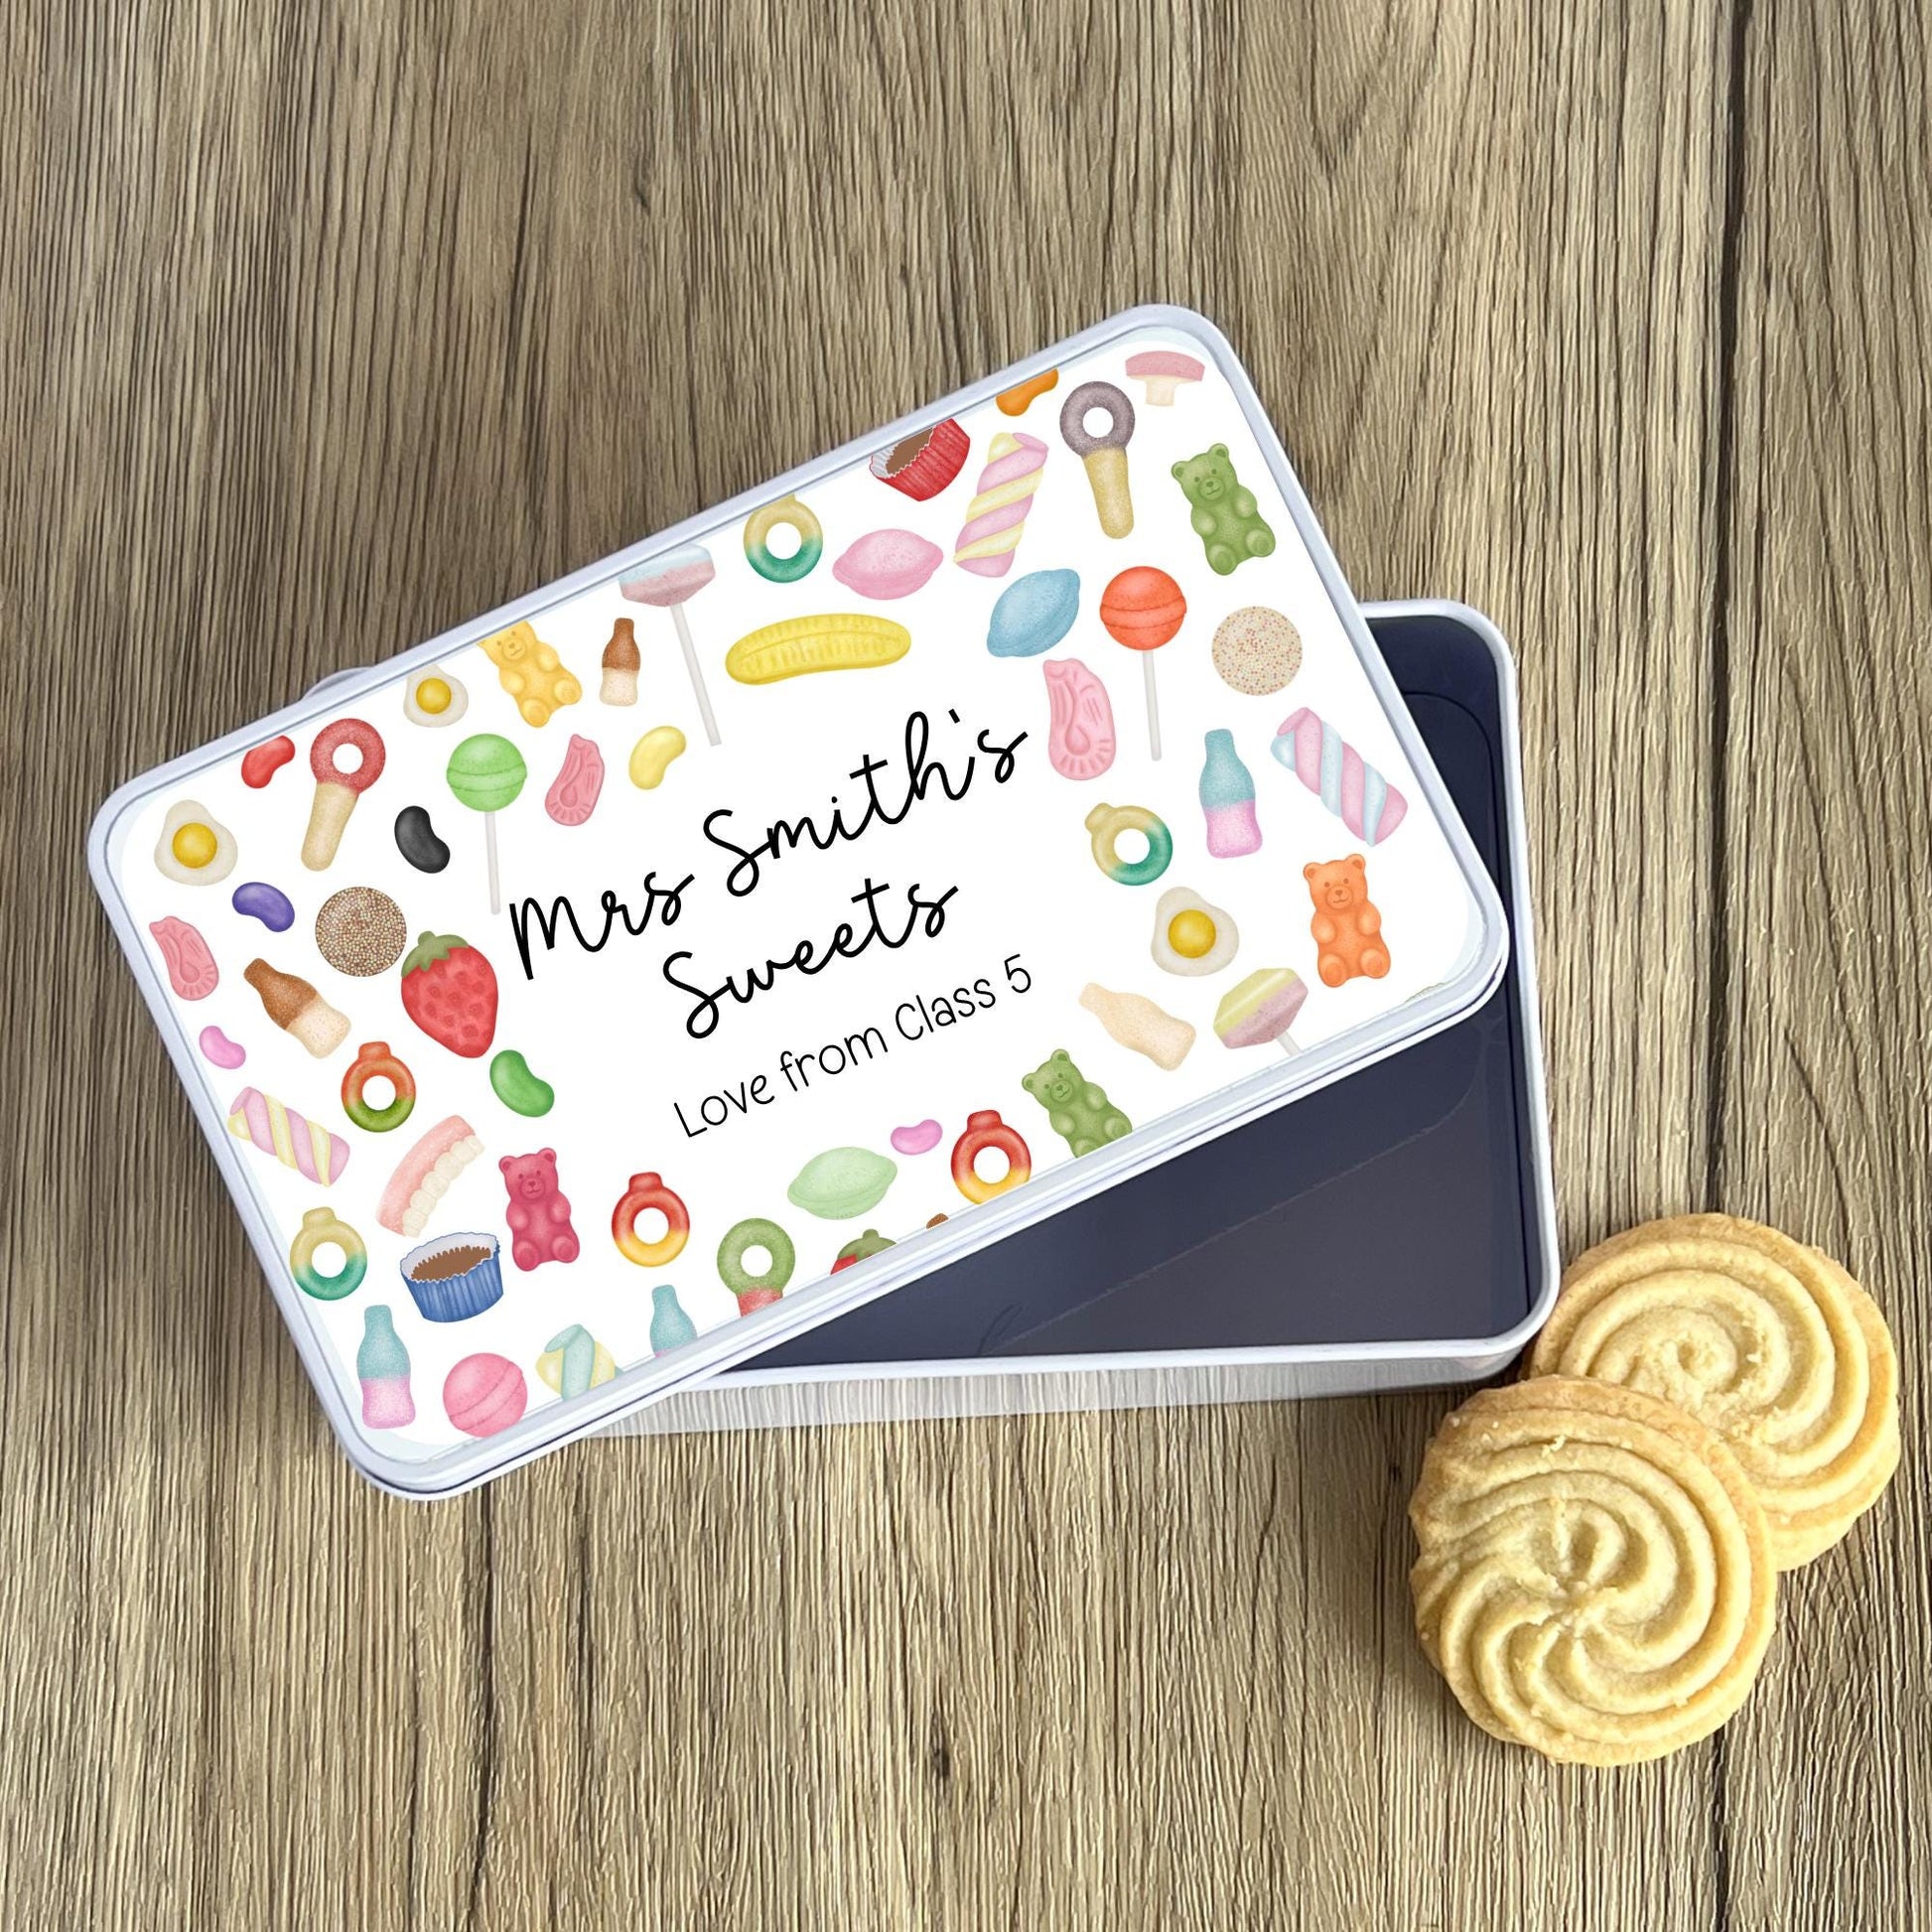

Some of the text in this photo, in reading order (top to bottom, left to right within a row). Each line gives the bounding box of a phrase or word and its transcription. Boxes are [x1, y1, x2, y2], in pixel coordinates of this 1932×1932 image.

[508, 708, 1029, 981] Mrs Smith's
[662, 878, 959, 1039] Sweets
[673, 953, 1032, 1138] Love from Class 5
